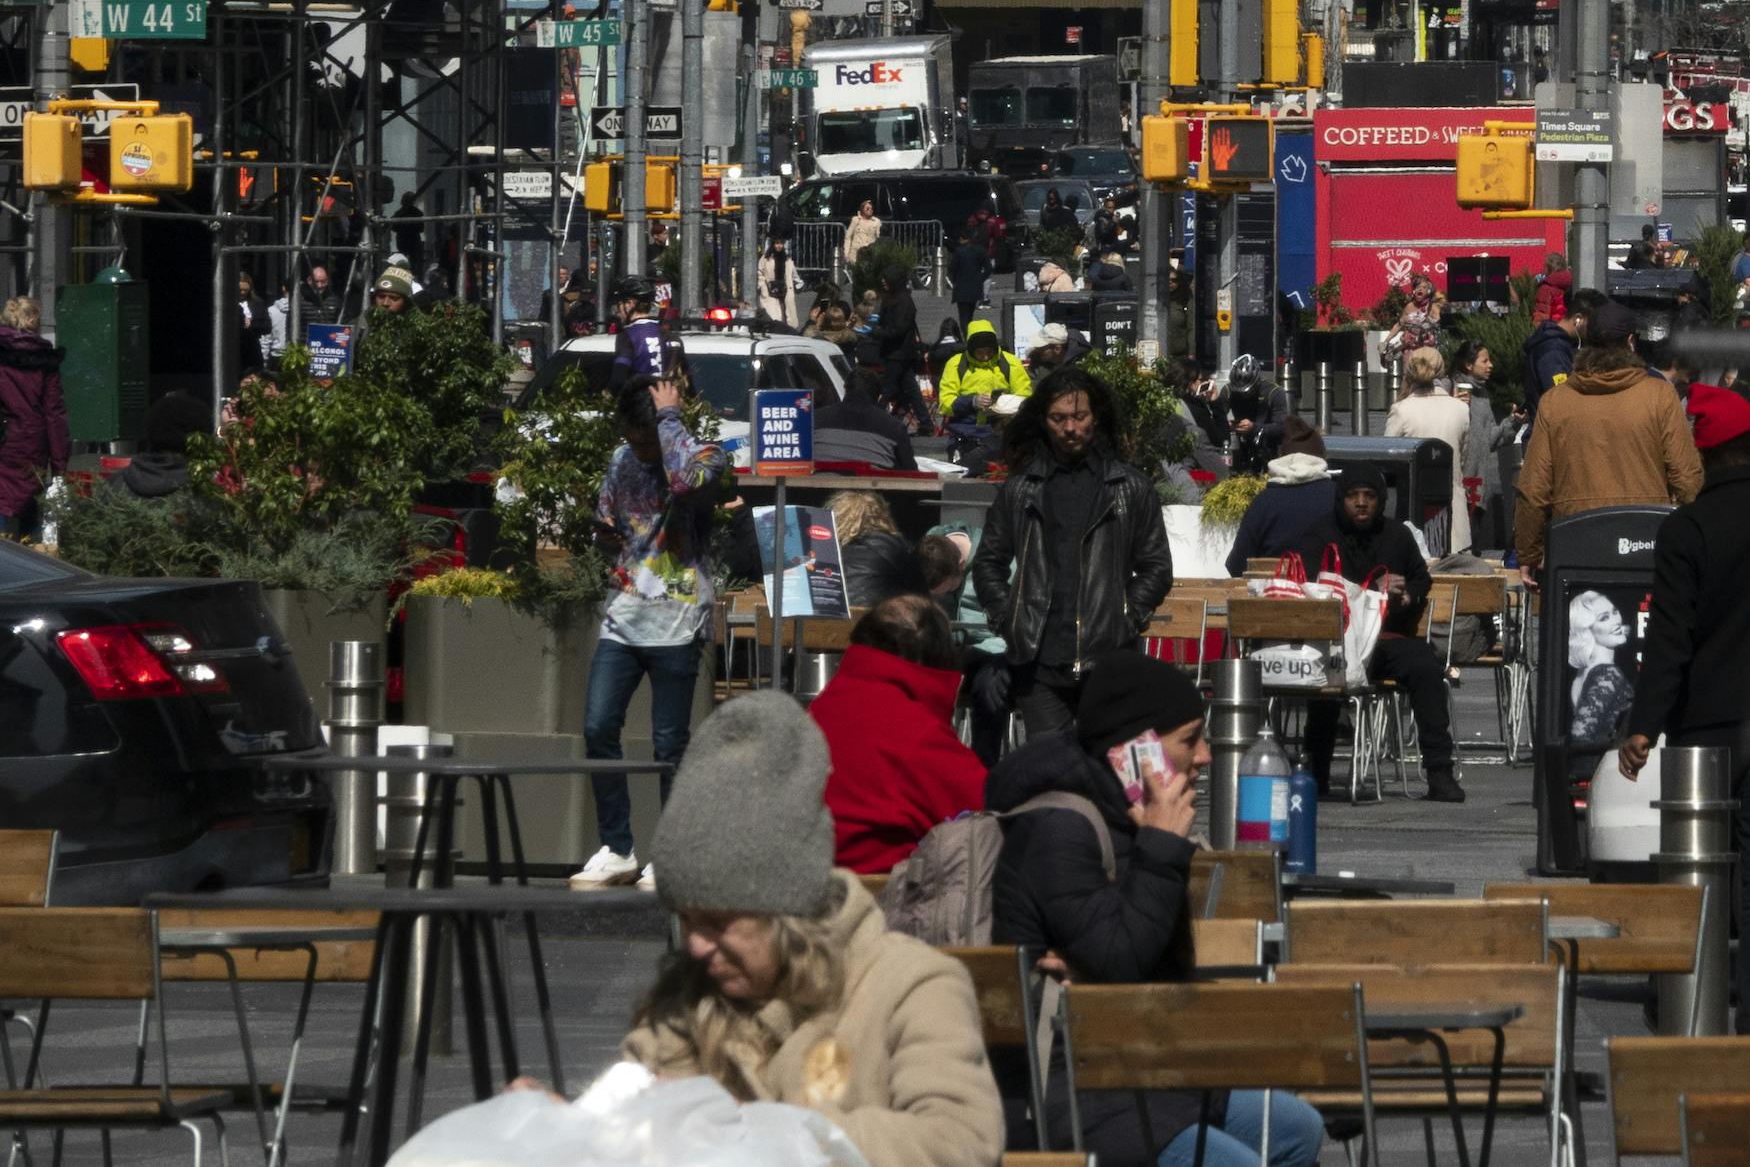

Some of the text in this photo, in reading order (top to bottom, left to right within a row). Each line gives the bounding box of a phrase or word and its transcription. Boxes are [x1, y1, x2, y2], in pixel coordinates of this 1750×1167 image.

[107, 2, 203, 33] W 44 St
[558, 22, 621, 42] W 45 St
[772, 71, 818, 85] W 46 St
[836, 62, 903, 85] FedEx
[5, 104, 34, 125] ON
[604, 115, 626, 130] ON
[1540, 122, 1601, 133] Times Square
[1324, 127, 1430, 145] COFFEED
[1540, 133, 1610, 142] Pedestrian Plaza
[1105, 320, 1132, 331] DON'T
[1106, 335, 1118, 345] BE
[761, 407, 798, 419] BEER
[762, 420, 794, 432] AND
[762, 433, 800, 446] WINE
[762, 446, 802, 459] AREA
[1288, 659, 1312, 680] up
